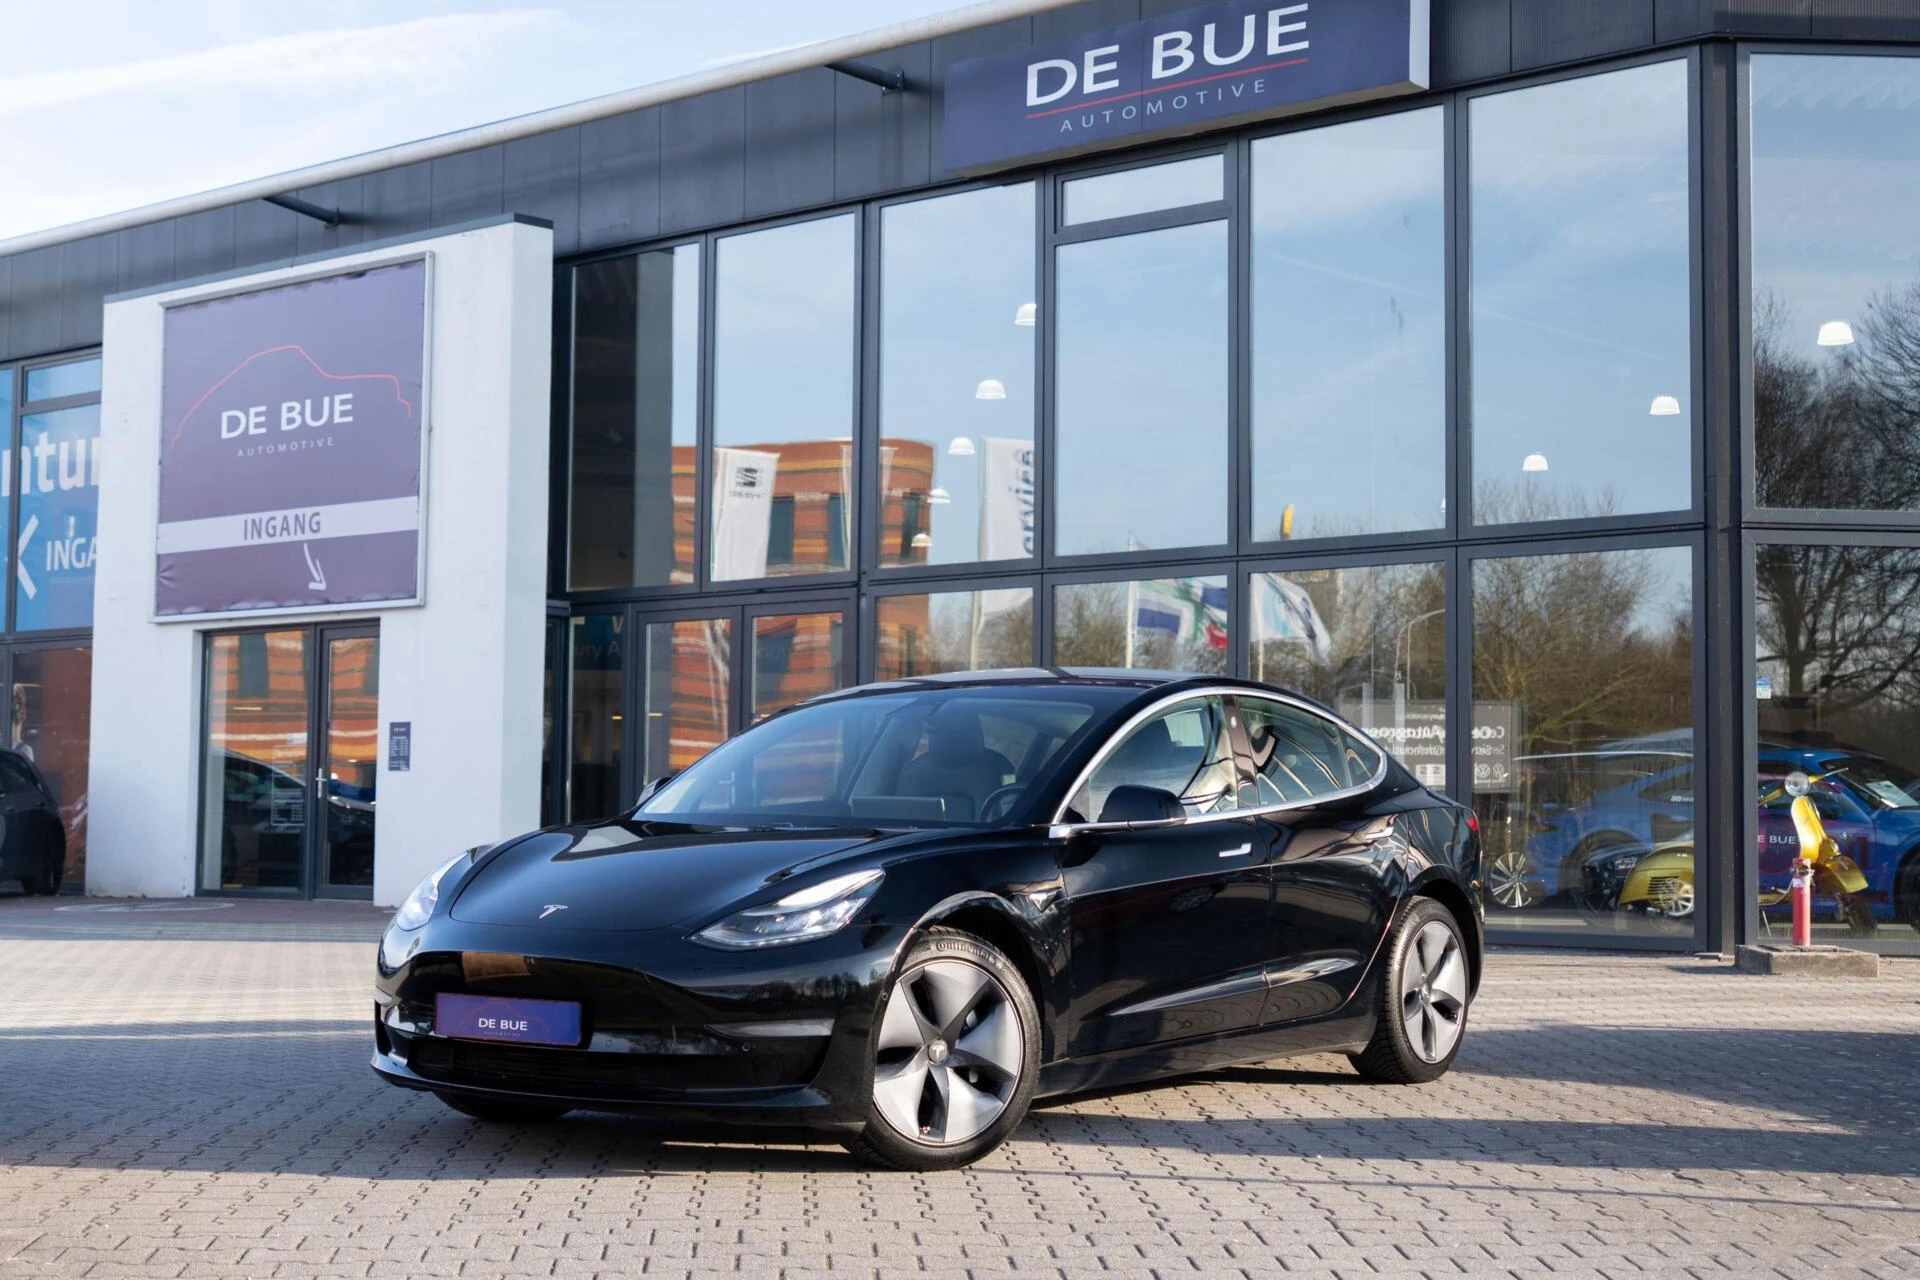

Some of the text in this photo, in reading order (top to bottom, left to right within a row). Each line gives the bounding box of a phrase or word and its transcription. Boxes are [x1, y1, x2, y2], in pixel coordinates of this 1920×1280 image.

[1026, 3, 1310, 106] DE BUE
[1060, 79, 1266, 133] AUTOMOTIVE
[221, 393, 354, 439] DE BUE
[237, 437, 334, 457] AUTOMOTIVE
[243, 511, 321, 541] INGANG
[1769, 835, 1796, 844] BUE
[478, 1018, 528, 1031] DE BUE
